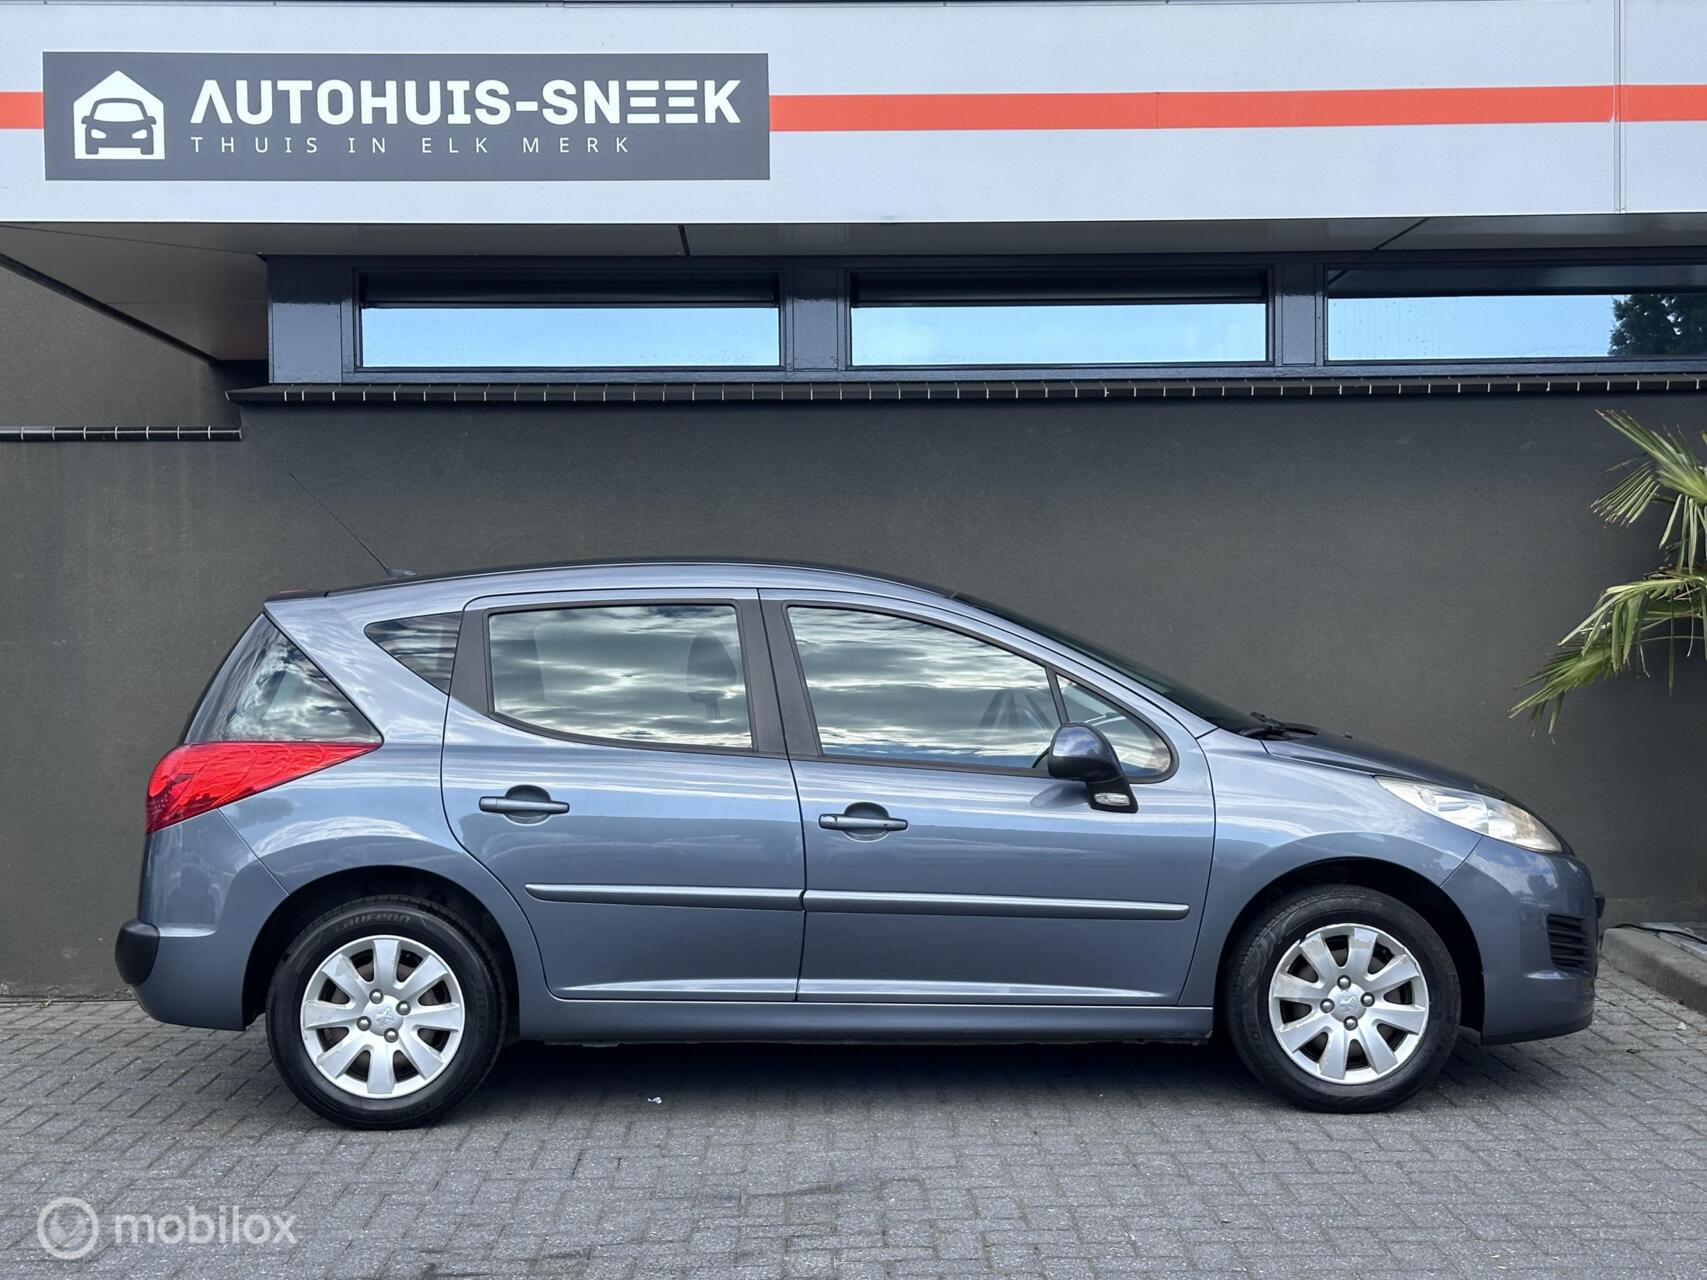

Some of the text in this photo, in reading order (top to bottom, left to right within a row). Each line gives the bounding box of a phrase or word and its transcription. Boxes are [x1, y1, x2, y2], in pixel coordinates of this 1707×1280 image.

[189, 79, 741, 126] AUTOHUIS-SNEEK
[190, 136, 628, 154] THUIS IN ELK MERK
